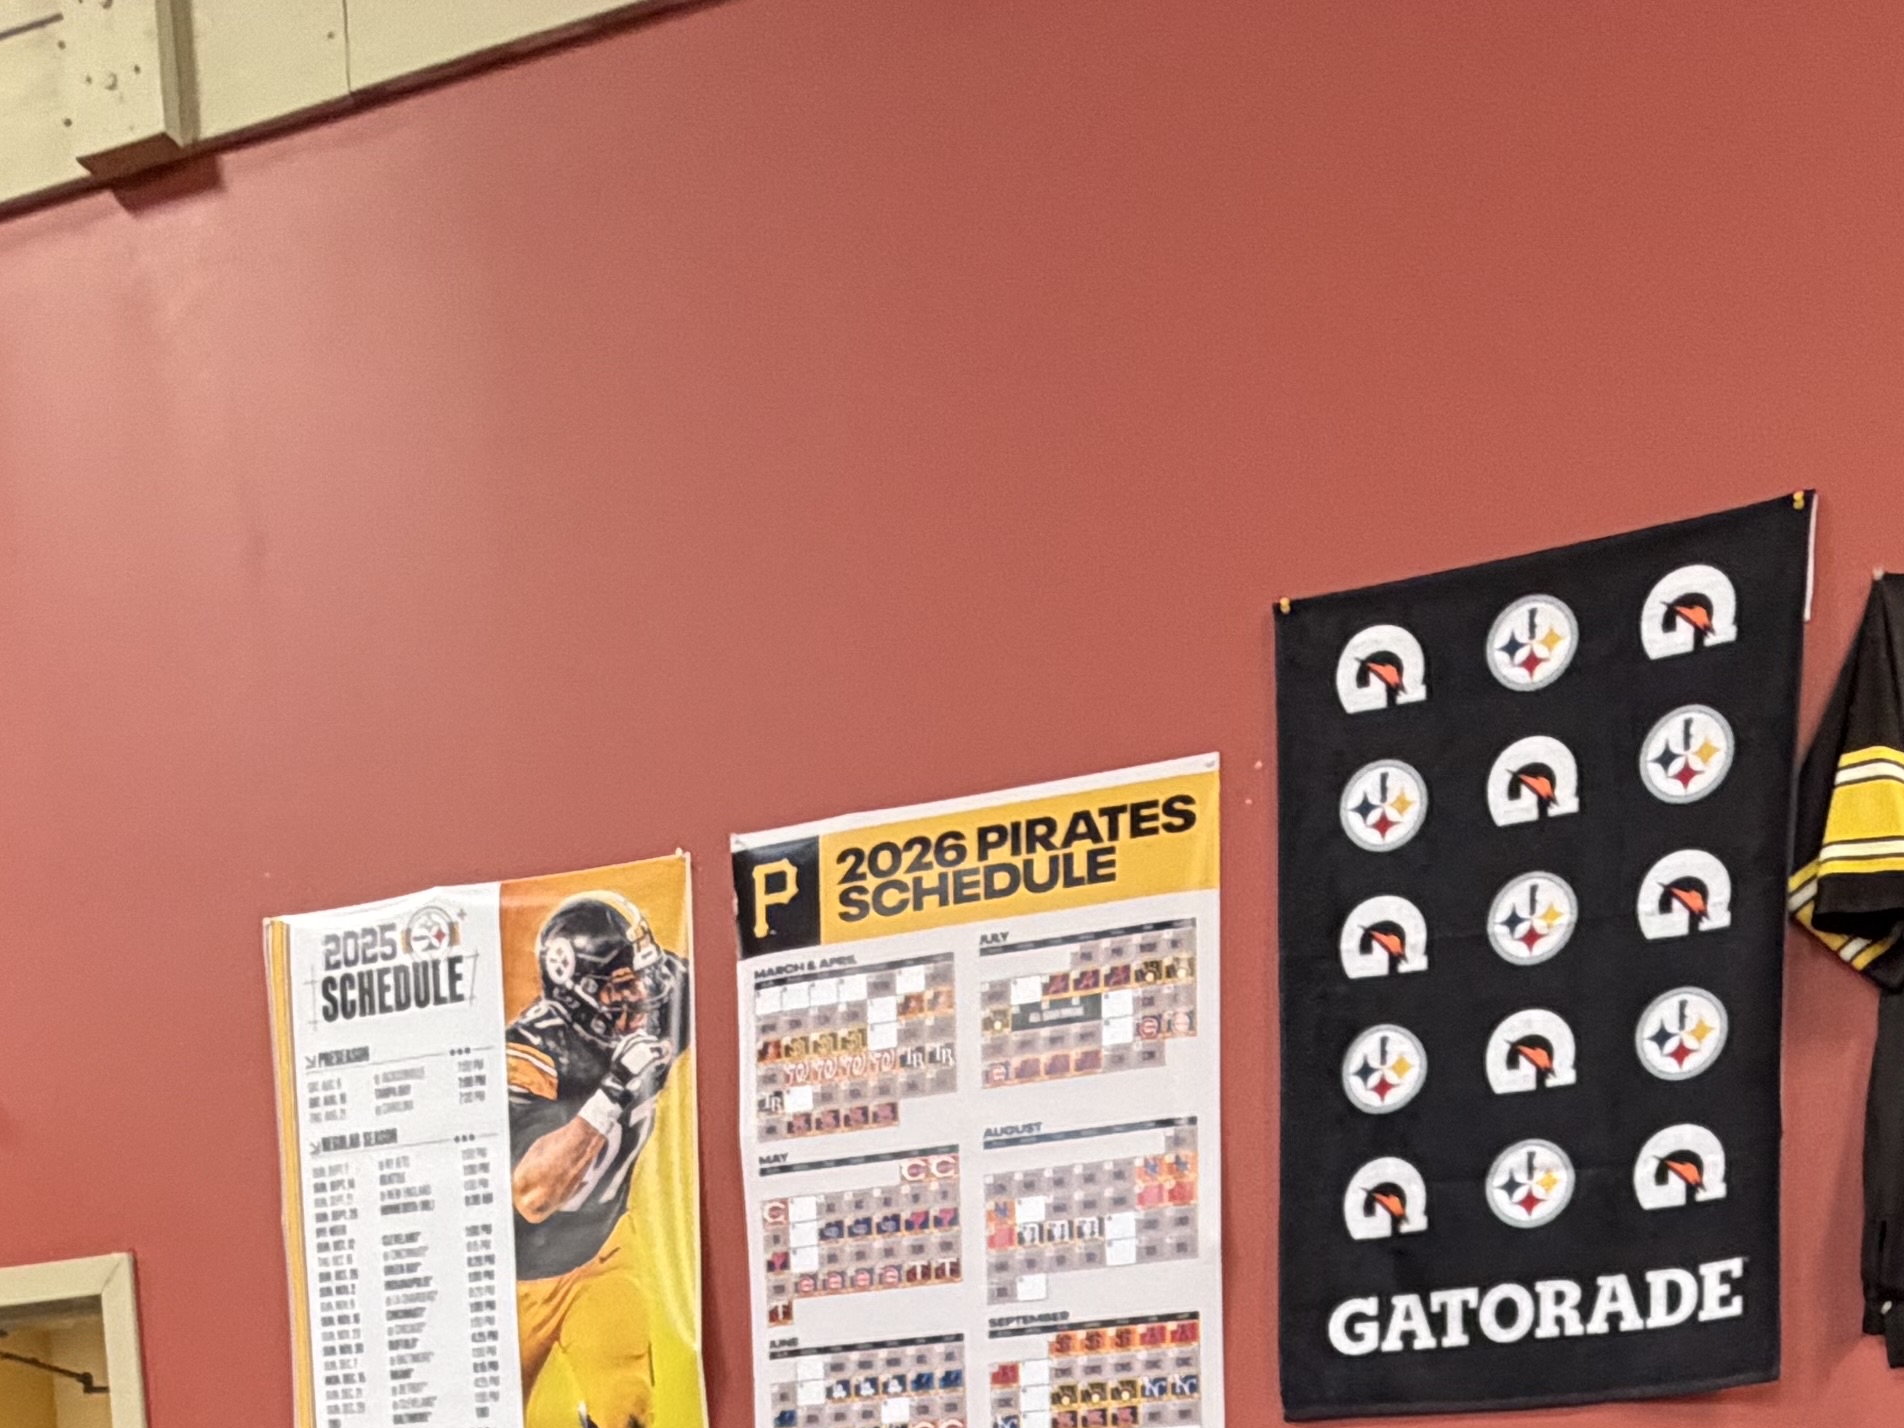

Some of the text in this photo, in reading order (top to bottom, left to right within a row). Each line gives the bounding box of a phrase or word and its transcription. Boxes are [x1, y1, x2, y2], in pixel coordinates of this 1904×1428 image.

[836, 795, 1197, 886] 2026 PIRATES
[752, 858, 799, 939] P
[837, 846, 1118, 922] SCHEDULE
[322, 922, 398, 972] 2025
[754, 962, 805, 979] MARCH
[321, 954, 465, 1023] SCHEDULE
[758, 1152, 789, 1165] MAY
[984, 1122, 1043, 1138] AUGUST
[988, 1311, 1070, 1328] SEPTEMBER
[1328, 1256, 1746, 1357] GATORADE
